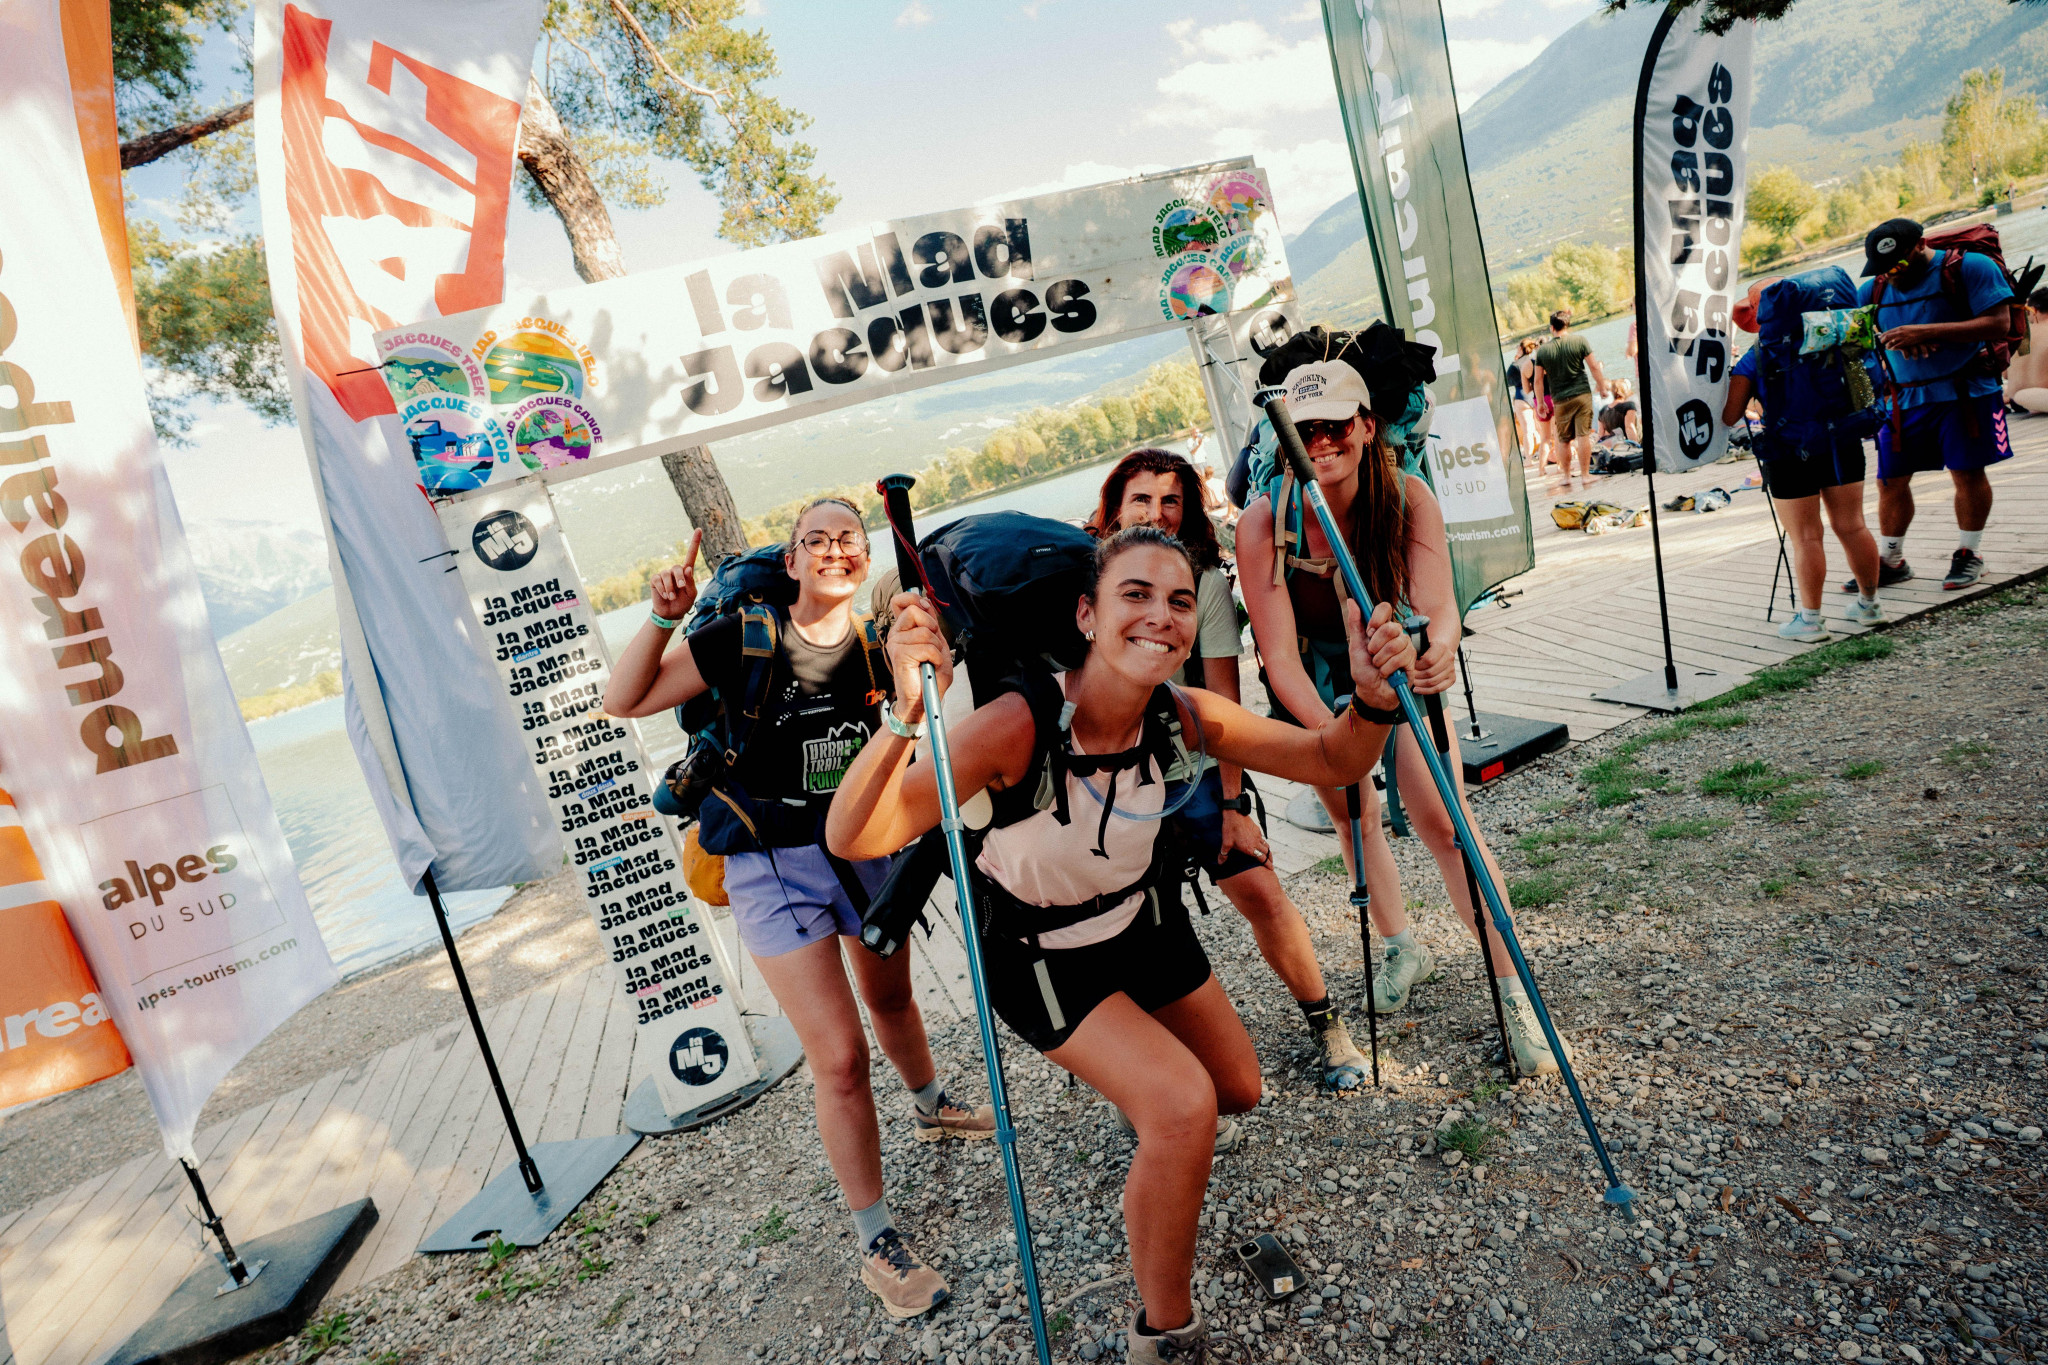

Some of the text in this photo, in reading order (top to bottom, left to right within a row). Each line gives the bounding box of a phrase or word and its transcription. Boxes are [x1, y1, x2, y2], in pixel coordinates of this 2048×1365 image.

[1152, 226, 1164, 258] MAD
[1206, 207, 1228, 239] VELO
[1667, 94, 1704, 356] la Mad
[1695, 62, 1734, 383] Jacques
[684, 218, 1034, 337] la Mad
[1161, 253, 1207, 286] JACQUES
[1160, 289, 1174, 321] MAD
[384, 333, 486, 397] JACQUES TREK
[680, 279, 1097, 416] Jacques
[577, 344, 600, 388] VELO
[1308, 391, 1323, 399] YORK
[513, 397, 572, 420] JACQUES
[573, 404, 603, 444] CANOE
[483, 417, 510, 464] STOP
[1433, 443, 1491, 479] lpes
[1442, 480, 1487, 497] U SUD
[1446, 525, 1521, 543] s-tourism.com
[484, 578, 560, 610] la Mad
[484, 589, 577, 626] Jacques
[497, 613, 573, 645] la Mad
[497, 623, 589, 661] Jacques
[510, 648, 585, 680] la Mad
[510, 659, 601, 696] Jacques
[523, 683, 597, 715] la Mad
[523, 694, 603, 730] Jacque
[536, 719, 611, 749] la Mad
[536, 726, 626, 765] Jacques
[809, 739, 851, 760] URBAN
[549, 750, 623, 783] la Mad
[549, 760, 638, 799] Jacques
[809, 771, 842, 790] POITI
[810, 756, 844, 773] TRAIL
[562, 784, 635, 817] la Mad
[562, 794, 651, 832] Jacques
[575, 819, 647, 850] la Mad
[575, 826, 663, 865] Jacques
[98, 844, 238, 911] alpes
[588, 850, 660, 883] la Mad
[588, 859, 675, 897] Jacques
[129, 892, 237, 940] DU SUD
[600, 882, 672, 915] la Mad
[600, 891, 687, 930] Jacques
[613, 915, 684, 947] la Mad
[613, 923, 699, 962] Jacques
[626, 945, 697, 979] la Mad
[626, 954, 711, 993] Jacques
[638, 977, 708, 1011] la Mad
[638, 985, 723, 1024] Jacques
[0, 992, 111, 1053] rea
[676, 1046, 721, 1075] MJ
[688, 1036, 703, 1049] la
